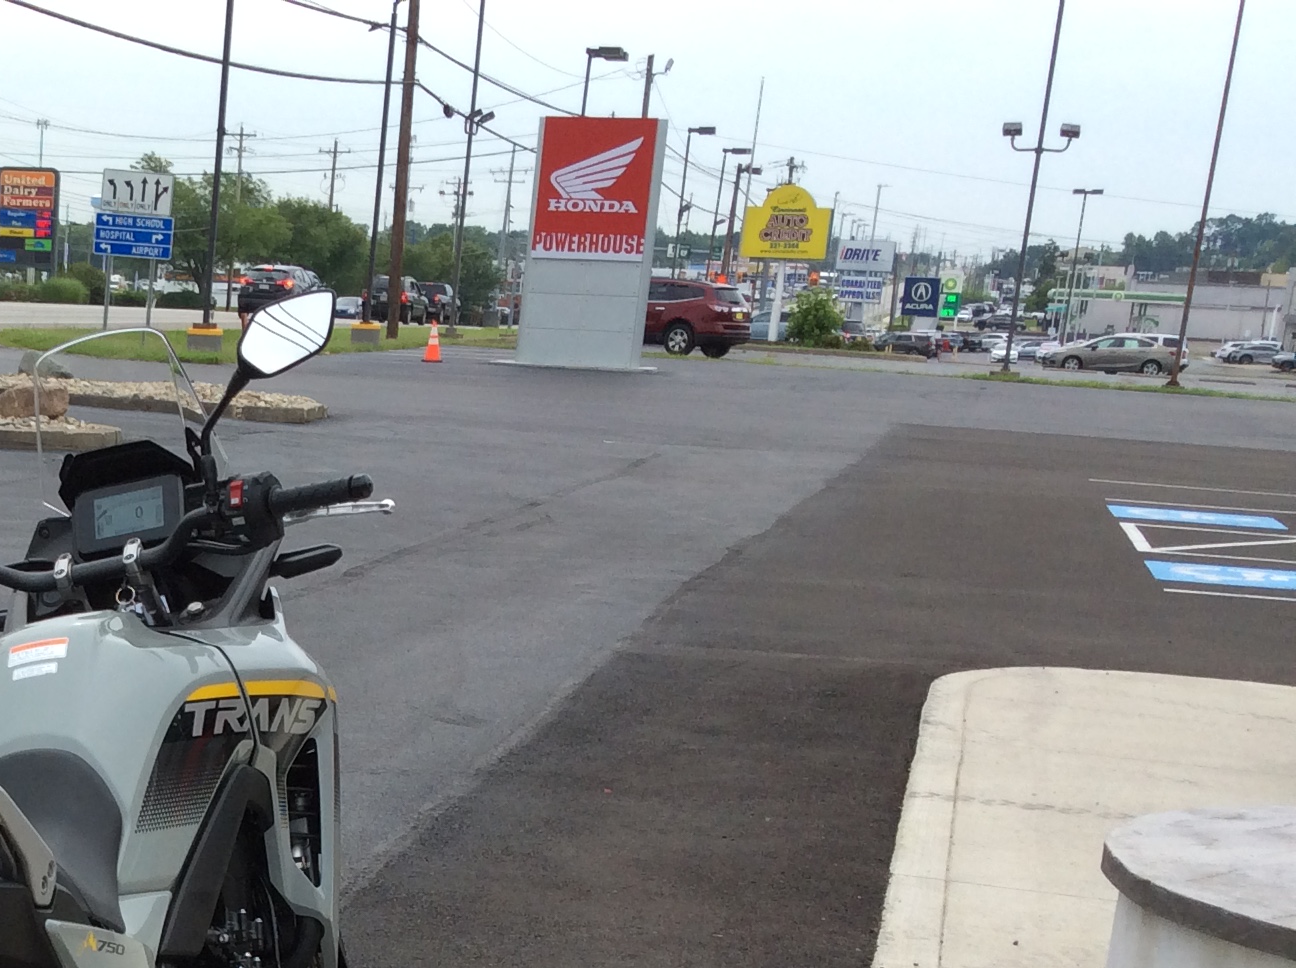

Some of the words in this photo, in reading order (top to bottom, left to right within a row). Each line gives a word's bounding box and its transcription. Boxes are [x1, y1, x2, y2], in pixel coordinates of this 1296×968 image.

[4, 174, 46, 185] United
[3, 185, 38, 197] Dairy
[3, 196, 51, 208] Farmers
[547, 199, 638, 213] HONDA
[115, 216, 134, 226] HIGH
[136, 218, 165, 229] SCHOOL
[766, 214, 809, 228] AUTO
[99, 229, 135, 241] HOSPITAL
[759, 229, 813, 242] CREDIT
[532, 232, 645, 255] POWERHOUSE
[131, 246, 163, 256] AIRPORT
[97, 939, 125, 956] 750
